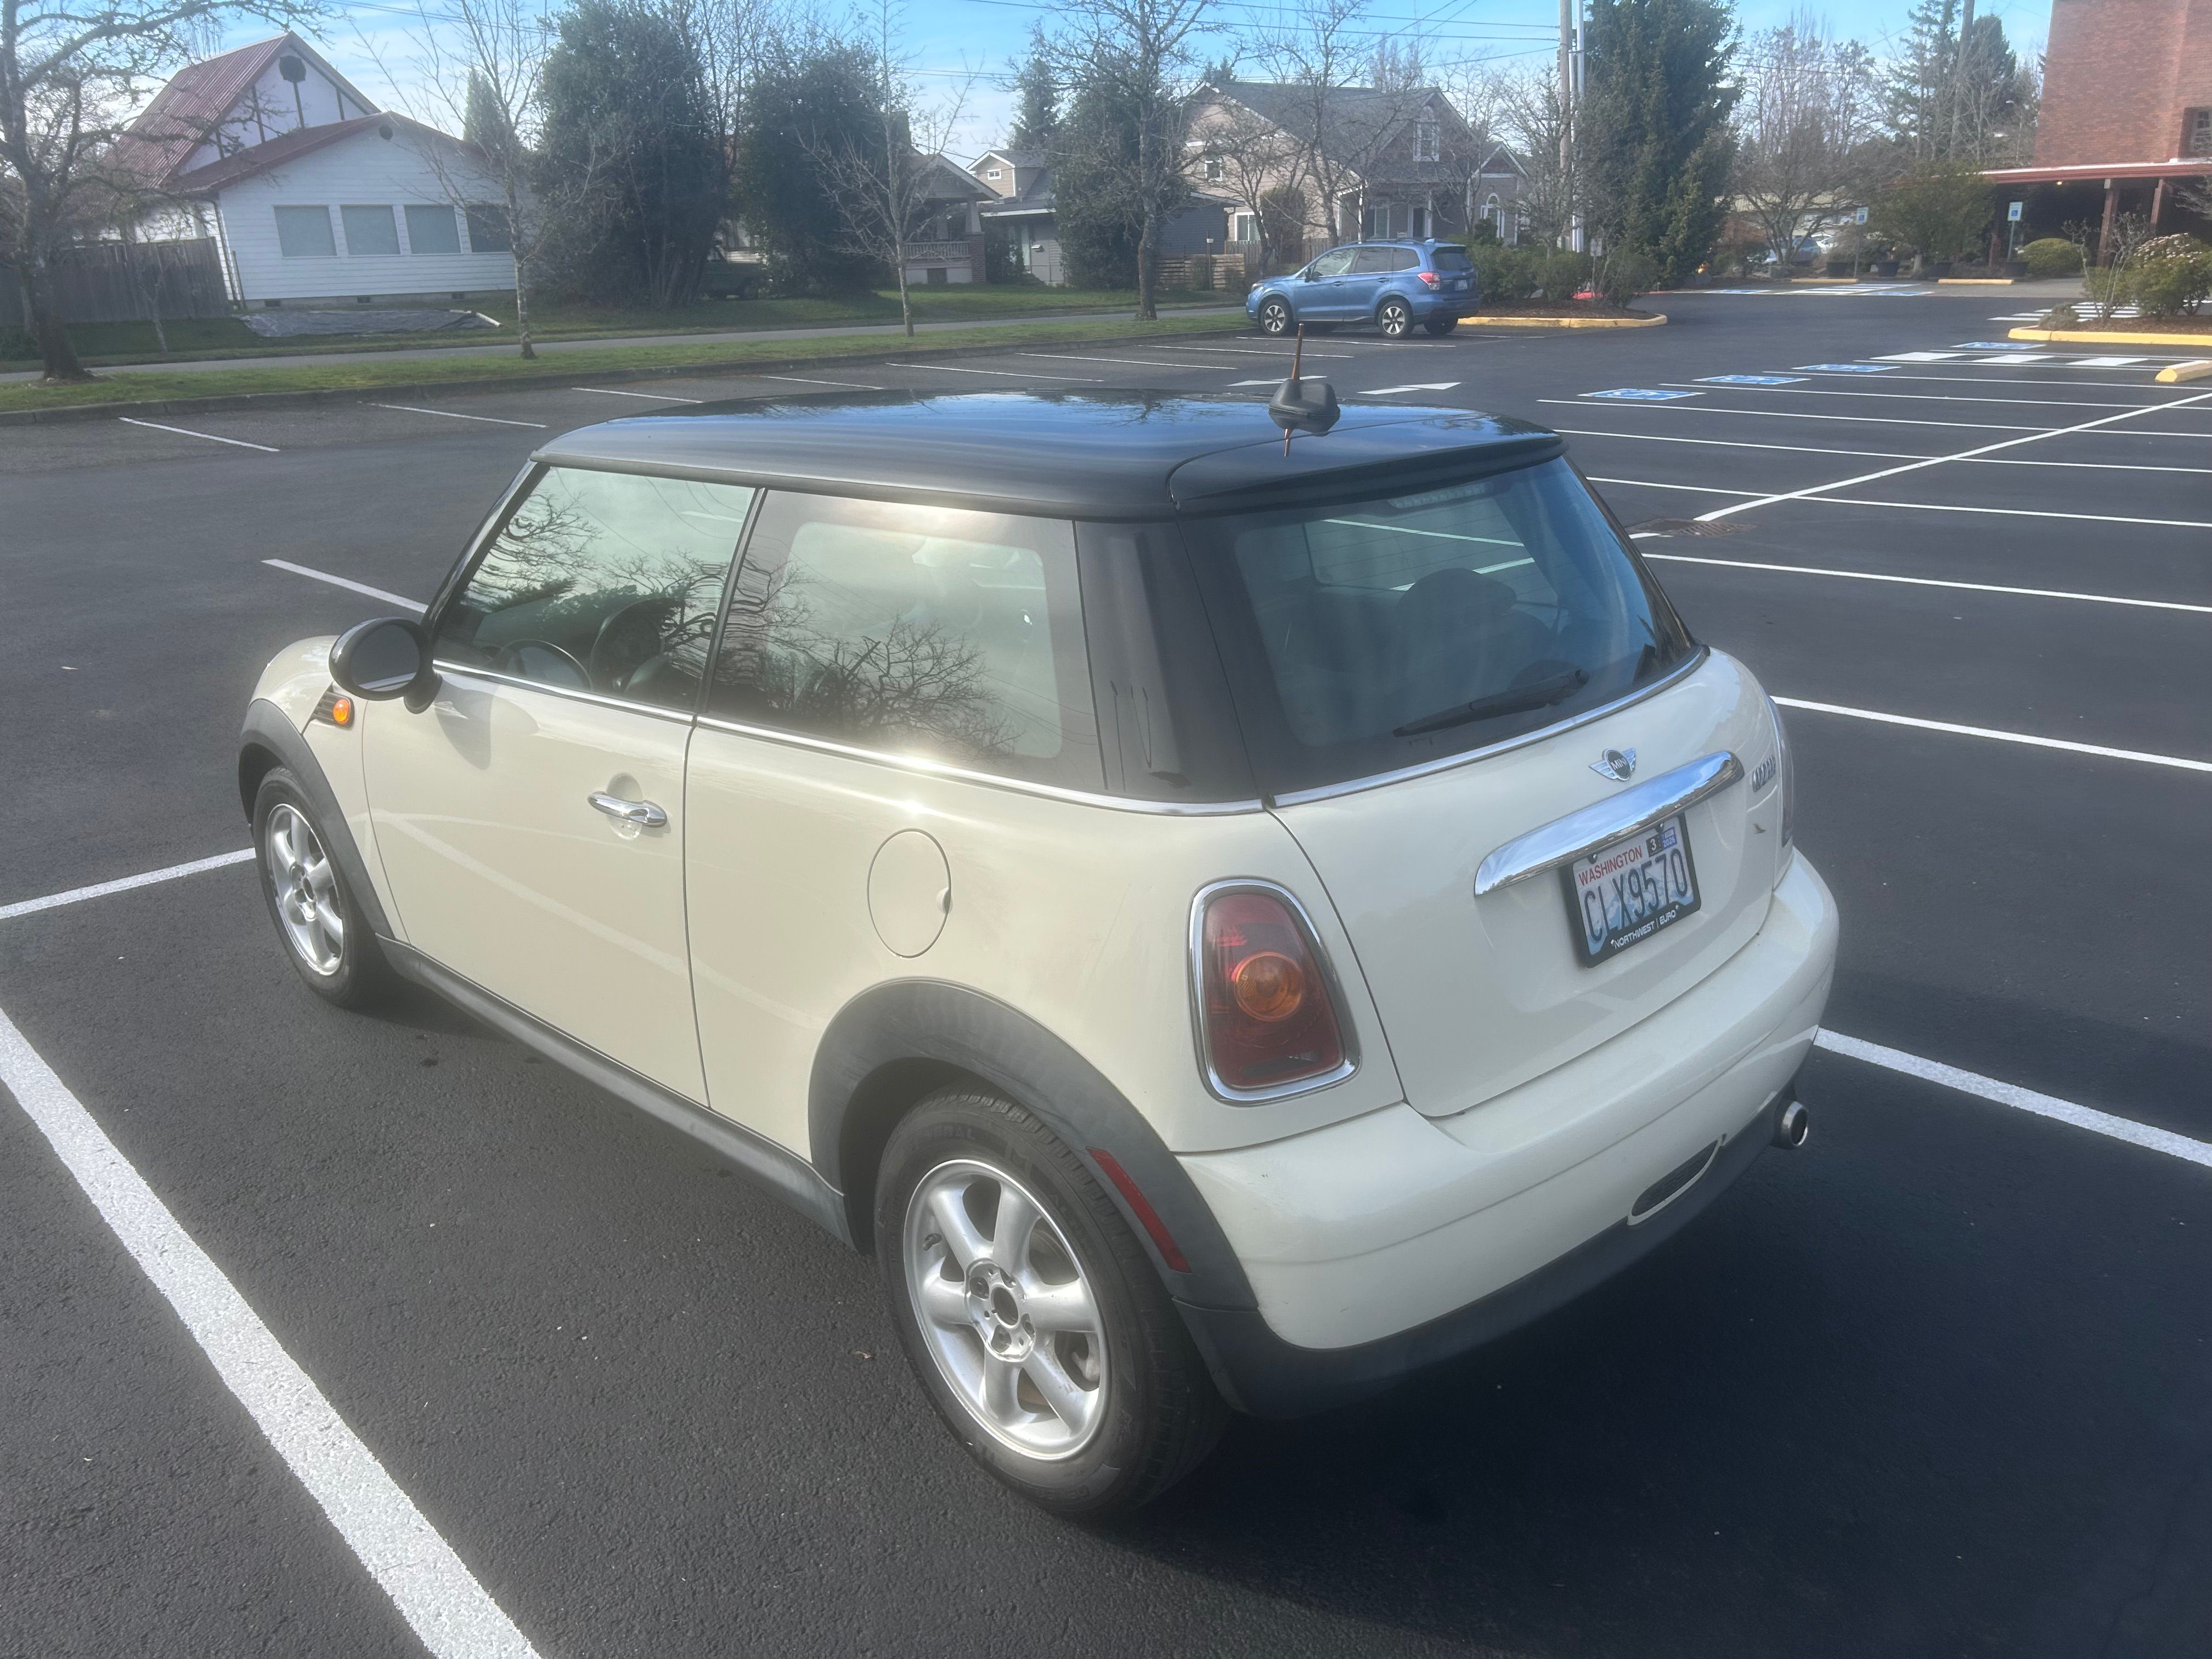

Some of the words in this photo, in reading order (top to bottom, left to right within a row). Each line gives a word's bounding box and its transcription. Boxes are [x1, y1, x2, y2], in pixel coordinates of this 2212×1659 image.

[1610, 757, 1627, 770] MINI
[1650, 838, 1657, 851] 3
[1578, 845, 1643, 886] WASHINGTON
[1584, 849, 1688, 941] CLX9570
[1614, 921, 1655, 949] NORTHWEST
[1659, 910, 1676, 926] EURO
